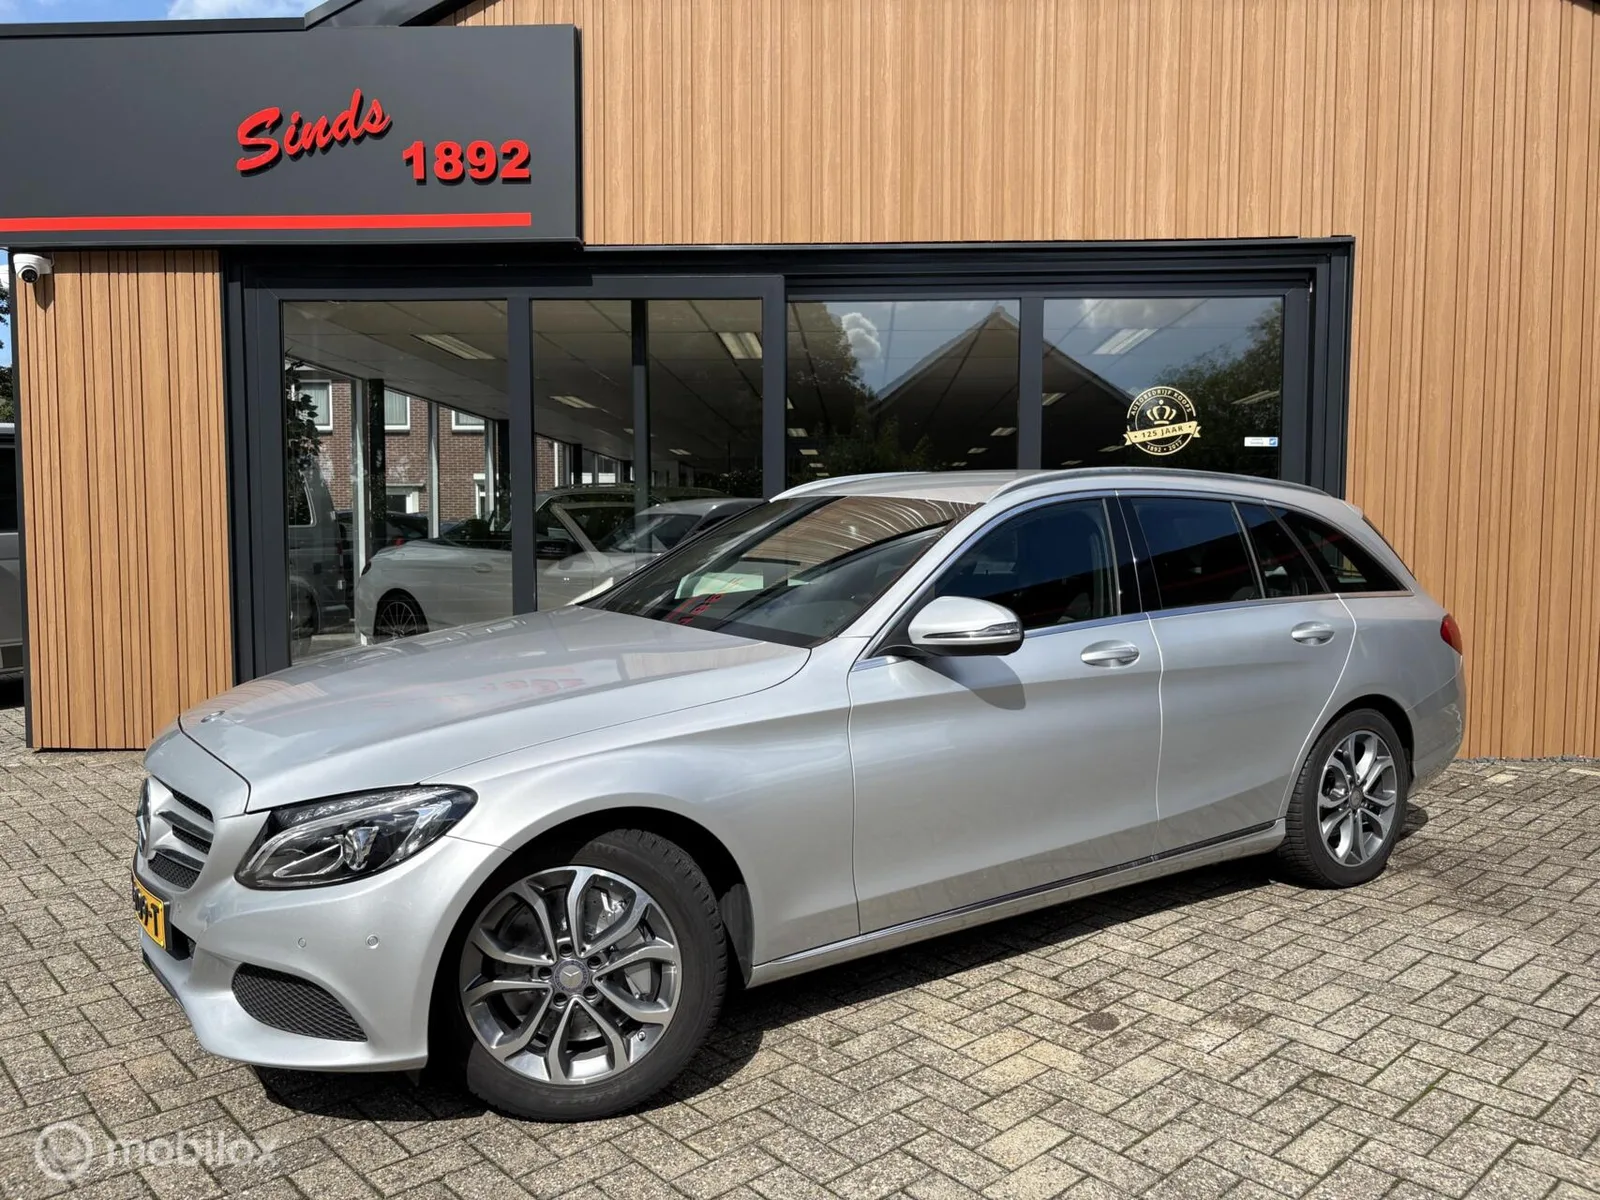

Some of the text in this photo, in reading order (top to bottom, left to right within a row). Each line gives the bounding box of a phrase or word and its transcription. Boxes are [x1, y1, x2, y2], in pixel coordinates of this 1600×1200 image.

[236, 88, 531, 181] Sinds 1892
[1131, 389, 1192, 416] AUTOBEDRIJF KOOPS
[1141, 425, 1184, 438] 125 JAAR
[1147, 439, 1183, 453] 1892 2017
